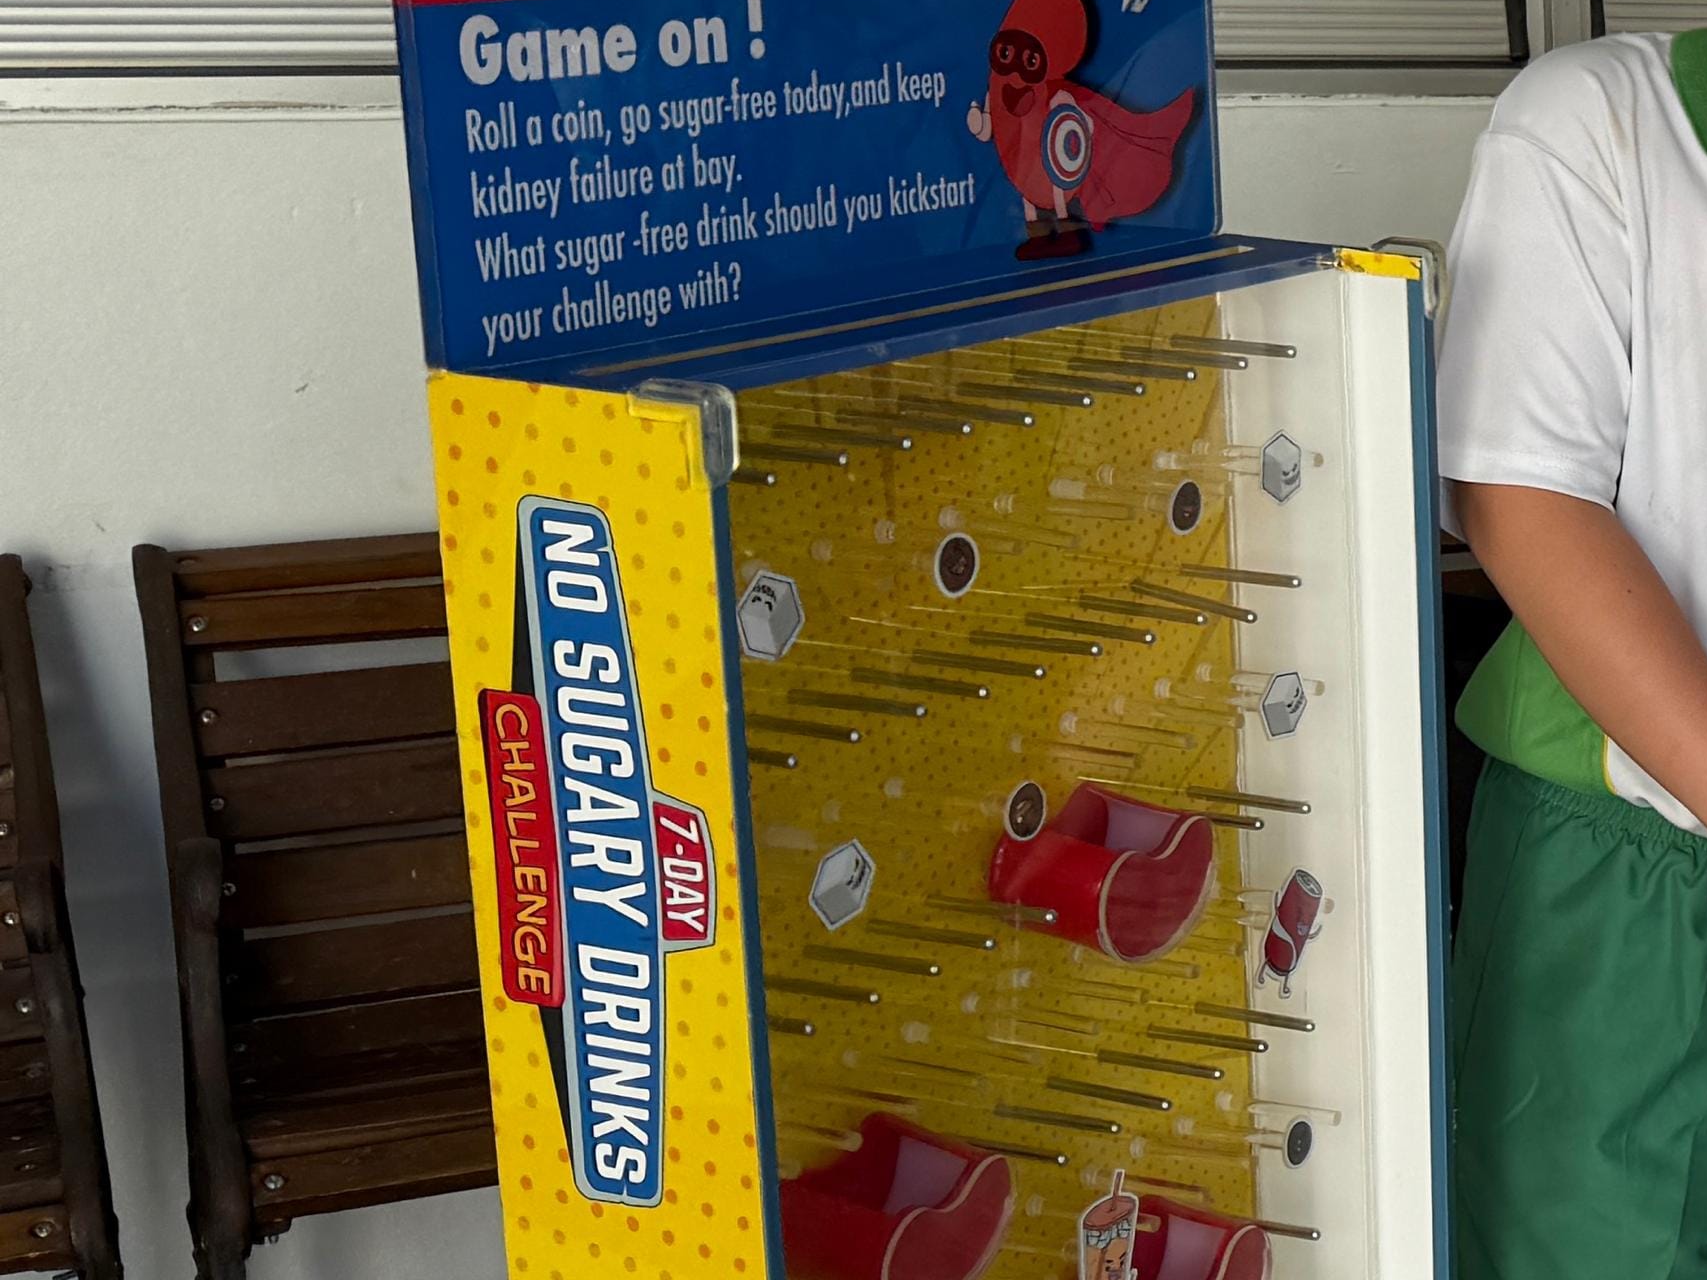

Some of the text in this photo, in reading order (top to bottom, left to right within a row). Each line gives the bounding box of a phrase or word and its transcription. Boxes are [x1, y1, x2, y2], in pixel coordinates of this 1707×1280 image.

[459, 14, 637, 86] Game
[658, 13, 729, 68] on
[465, 101, 518, 154] Roll
[526, 115, 543, 147] a
[551, 100, 612, 147] coin,
[620, 103, 651, 146] go
[659, 76, 777, 138] sugar-free
[896, 61, 946, 108] keep
[470, 143, 742, 219] kidney failure at bay.
[475, 232, 546, 283] What
[554, 230, 626, 276] sugar
[697, 196, 758, 248] drink
[764, 184, 837, 237] should
[843, 191, 883, 234] you
[888, 171, 976, 217] kickstart
[482, 261, 742, 358] your challenge with?
[495, 703, 552, 1000] CHALLENGE
[542, 518, 652, 1187] NO SUGARY DRINKS
[660, 814, 707, 939] 7-DAY
